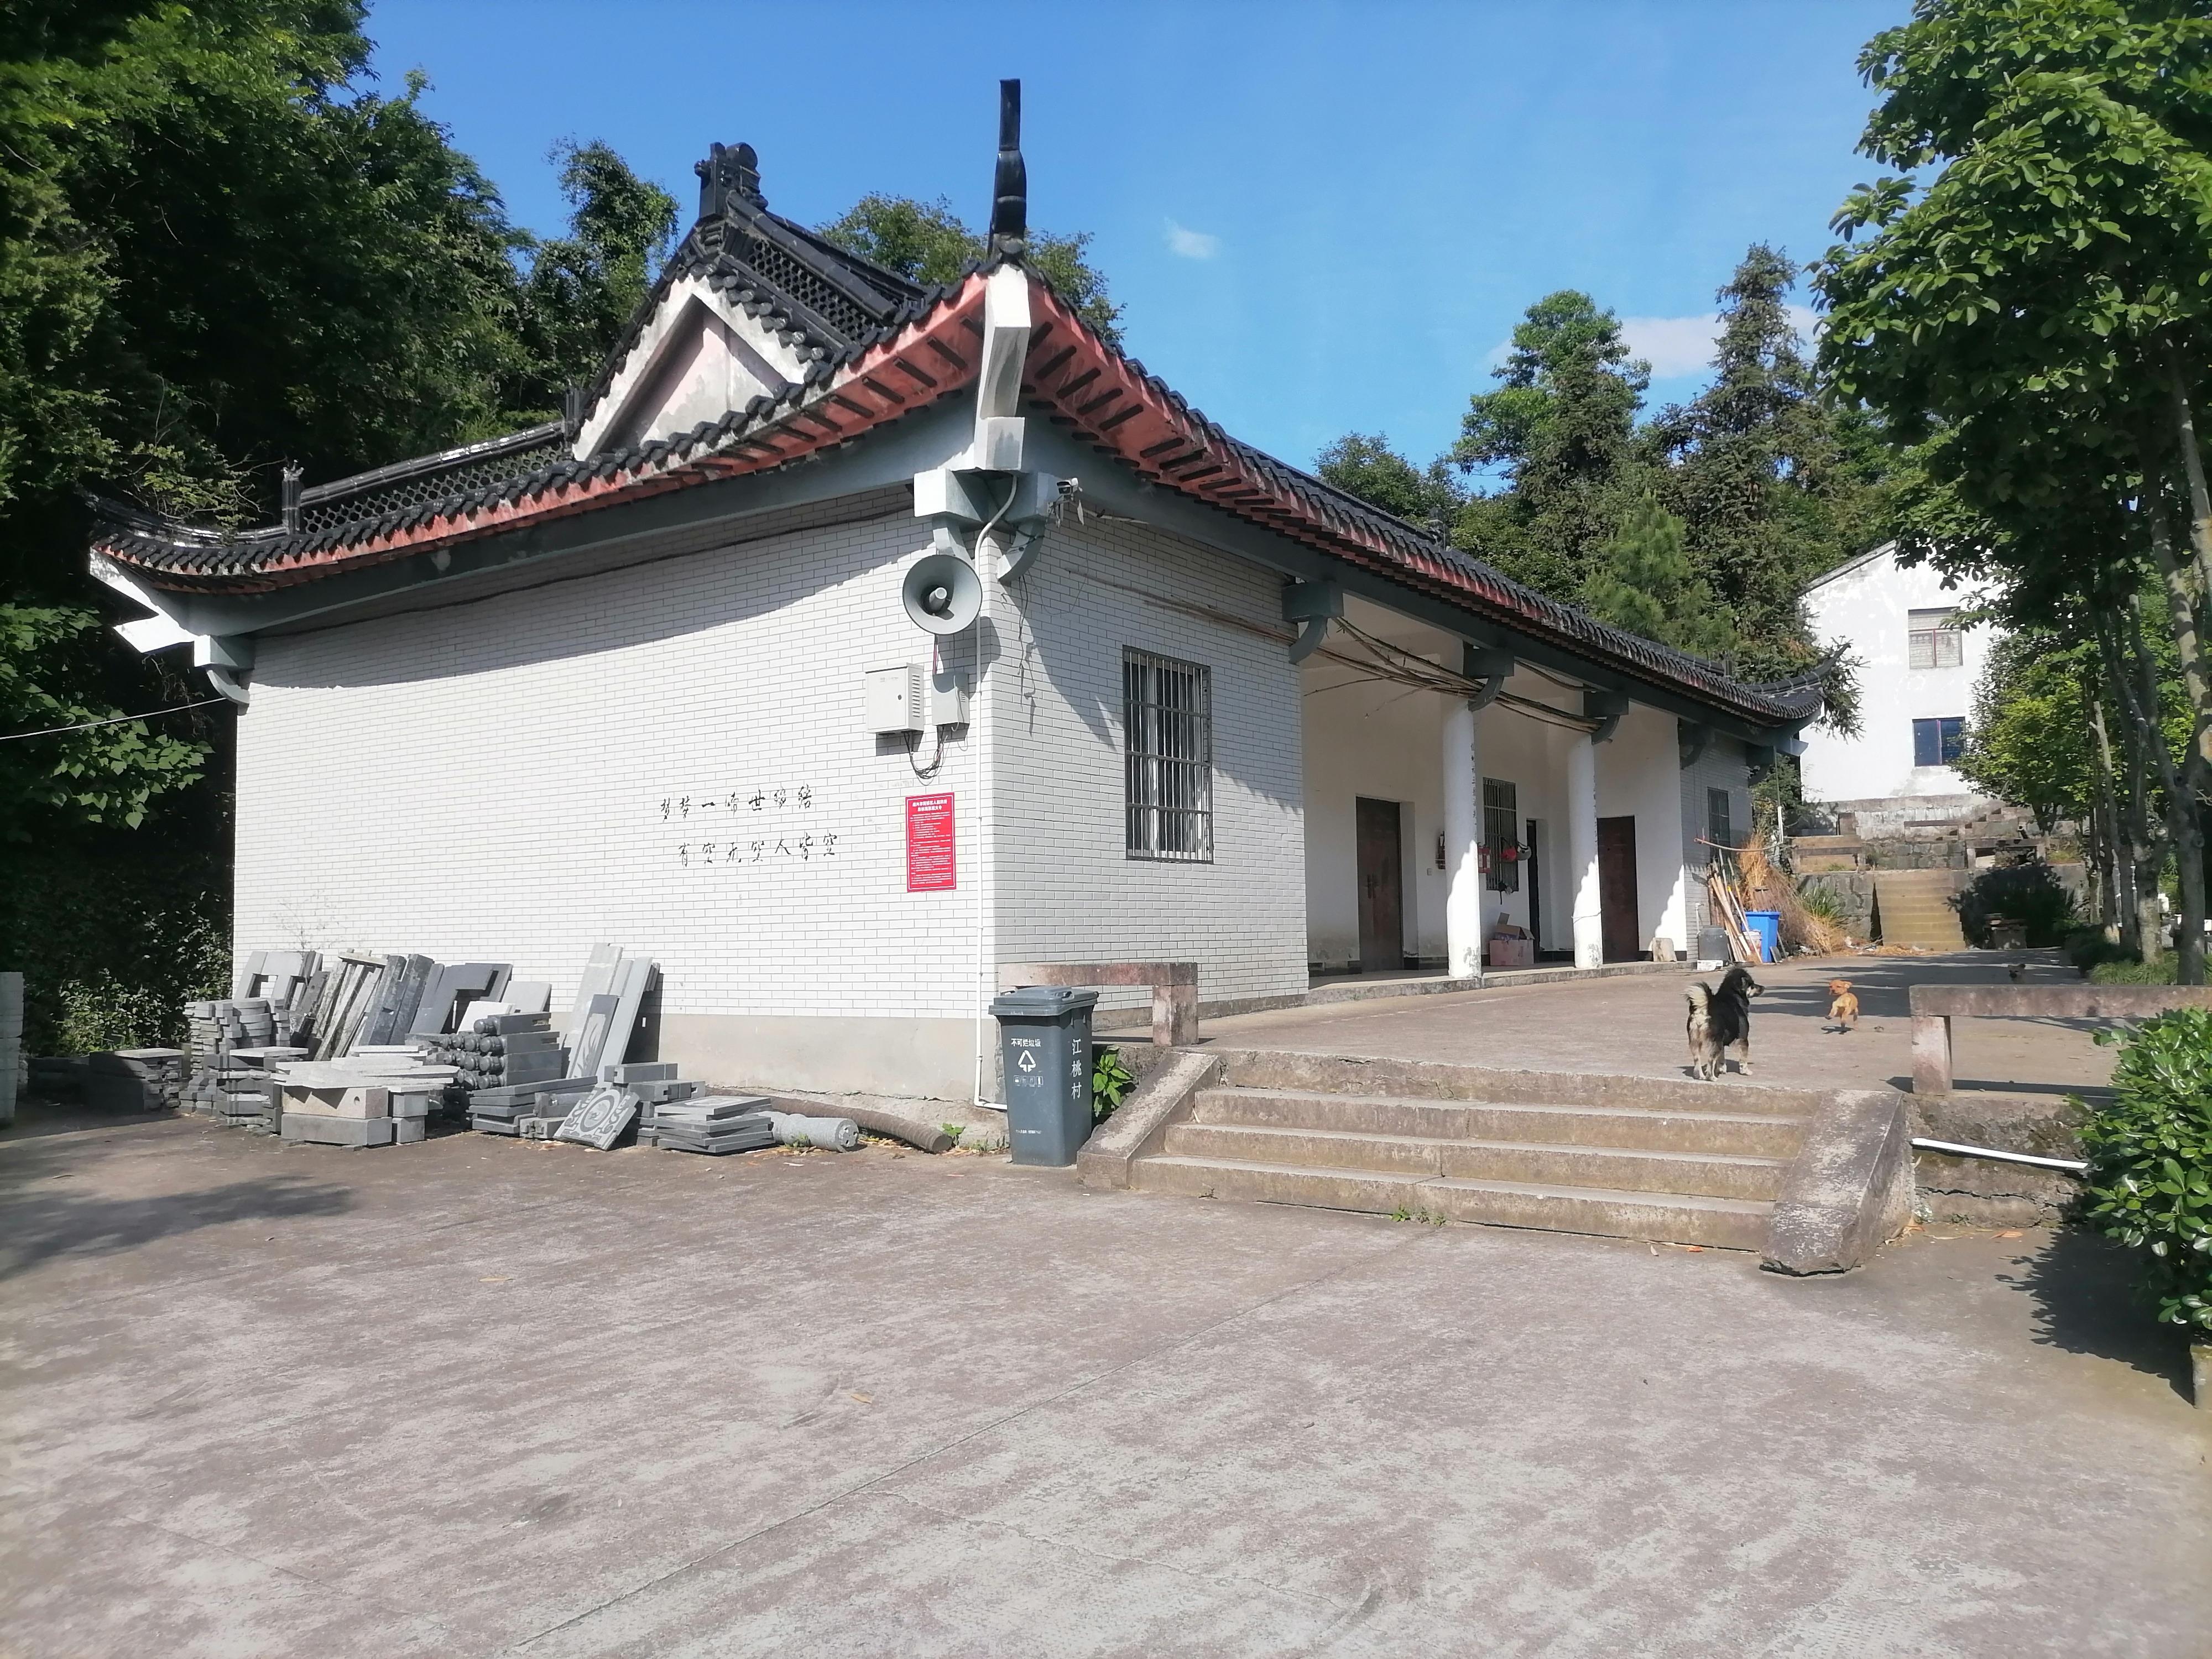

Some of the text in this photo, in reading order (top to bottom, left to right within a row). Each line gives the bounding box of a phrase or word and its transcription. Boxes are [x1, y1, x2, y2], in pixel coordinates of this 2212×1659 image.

[1011, 1038, 1042, 1047] 不可烂垃圾
[1071, 1039, 1082, 1100] 江桃村
